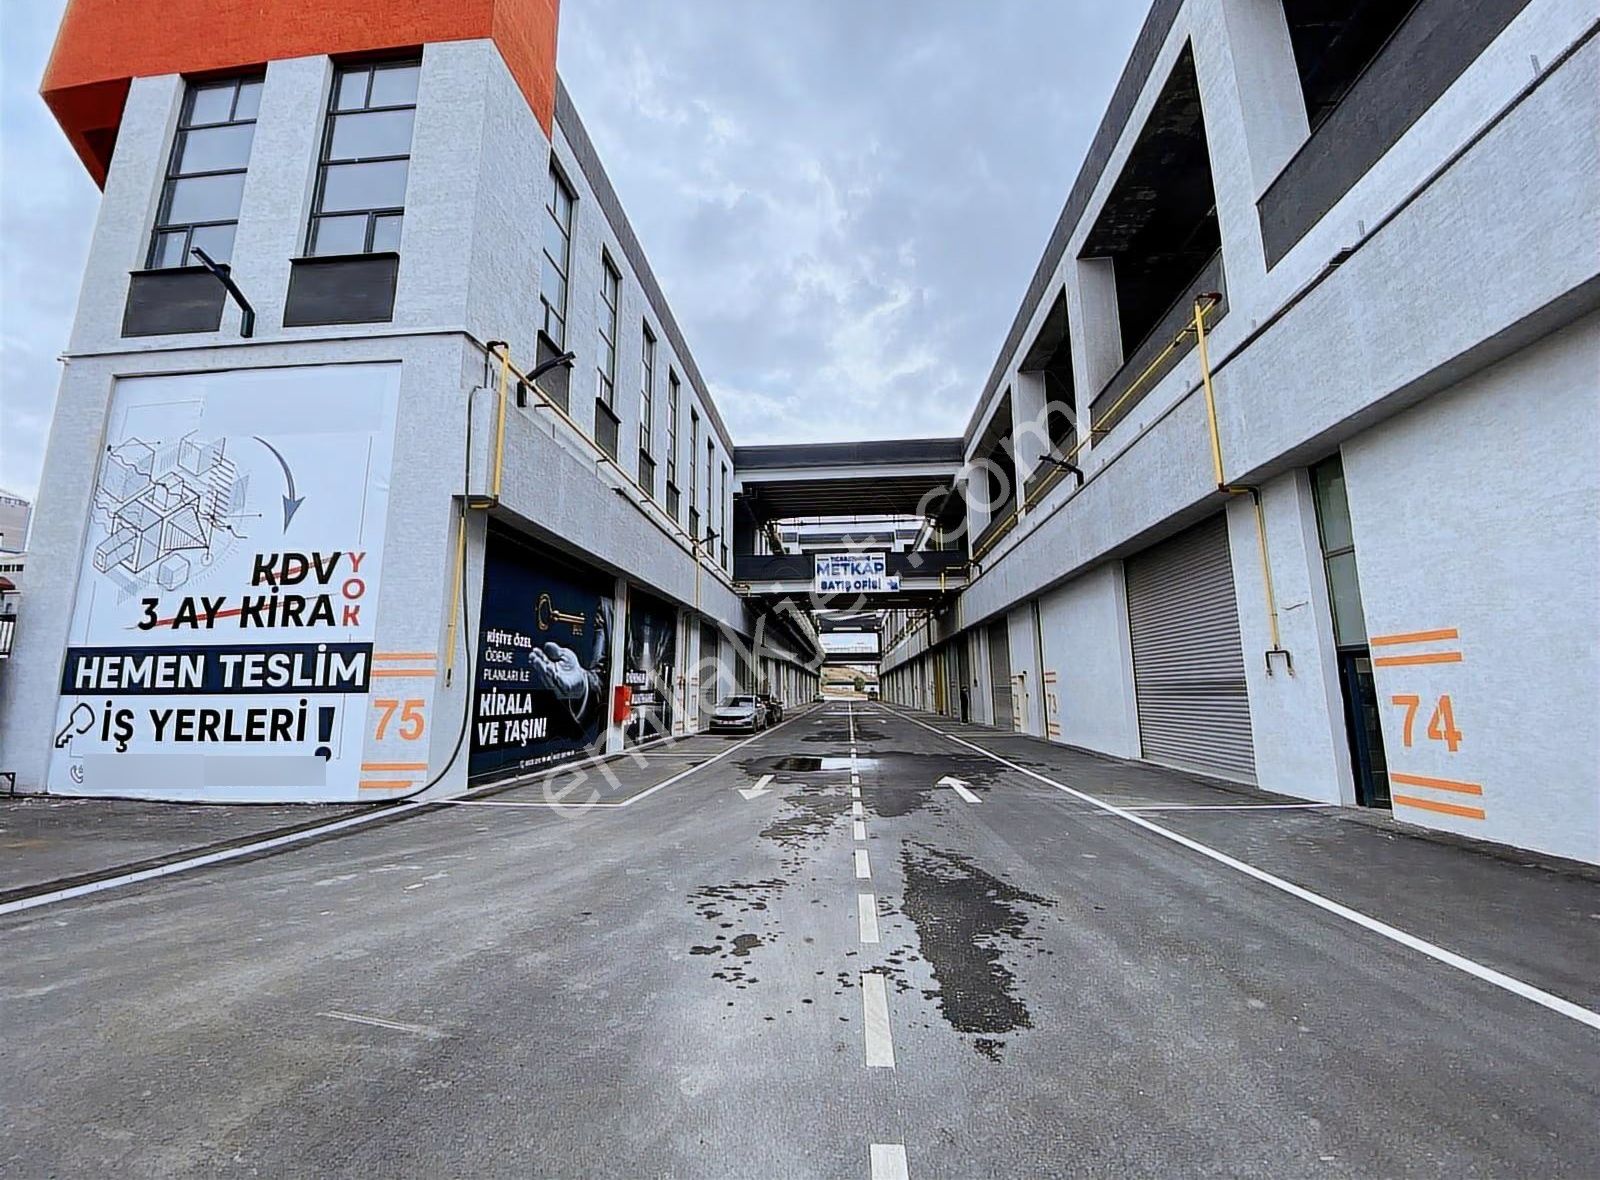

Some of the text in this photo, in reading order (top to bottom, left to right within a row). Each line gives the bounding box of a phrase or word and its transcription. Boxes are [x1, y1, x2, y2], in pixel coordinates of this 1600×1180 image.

[251, 551, 342, 587] KDV
[817, 562, 884, 576] METKAP
[137, 586, 336, 631] 3 AY KİRA
[74, 643, 368, 690] HEMEN TESLİM
[372, 698, 426, 741] 75
[479, 686, 533, 717] KİRALA
[1391, 693, 1463, 752] 74
[100, 700, 135, 753] İŞ
[477, 716, 548, 747] VE TAŞIN!
